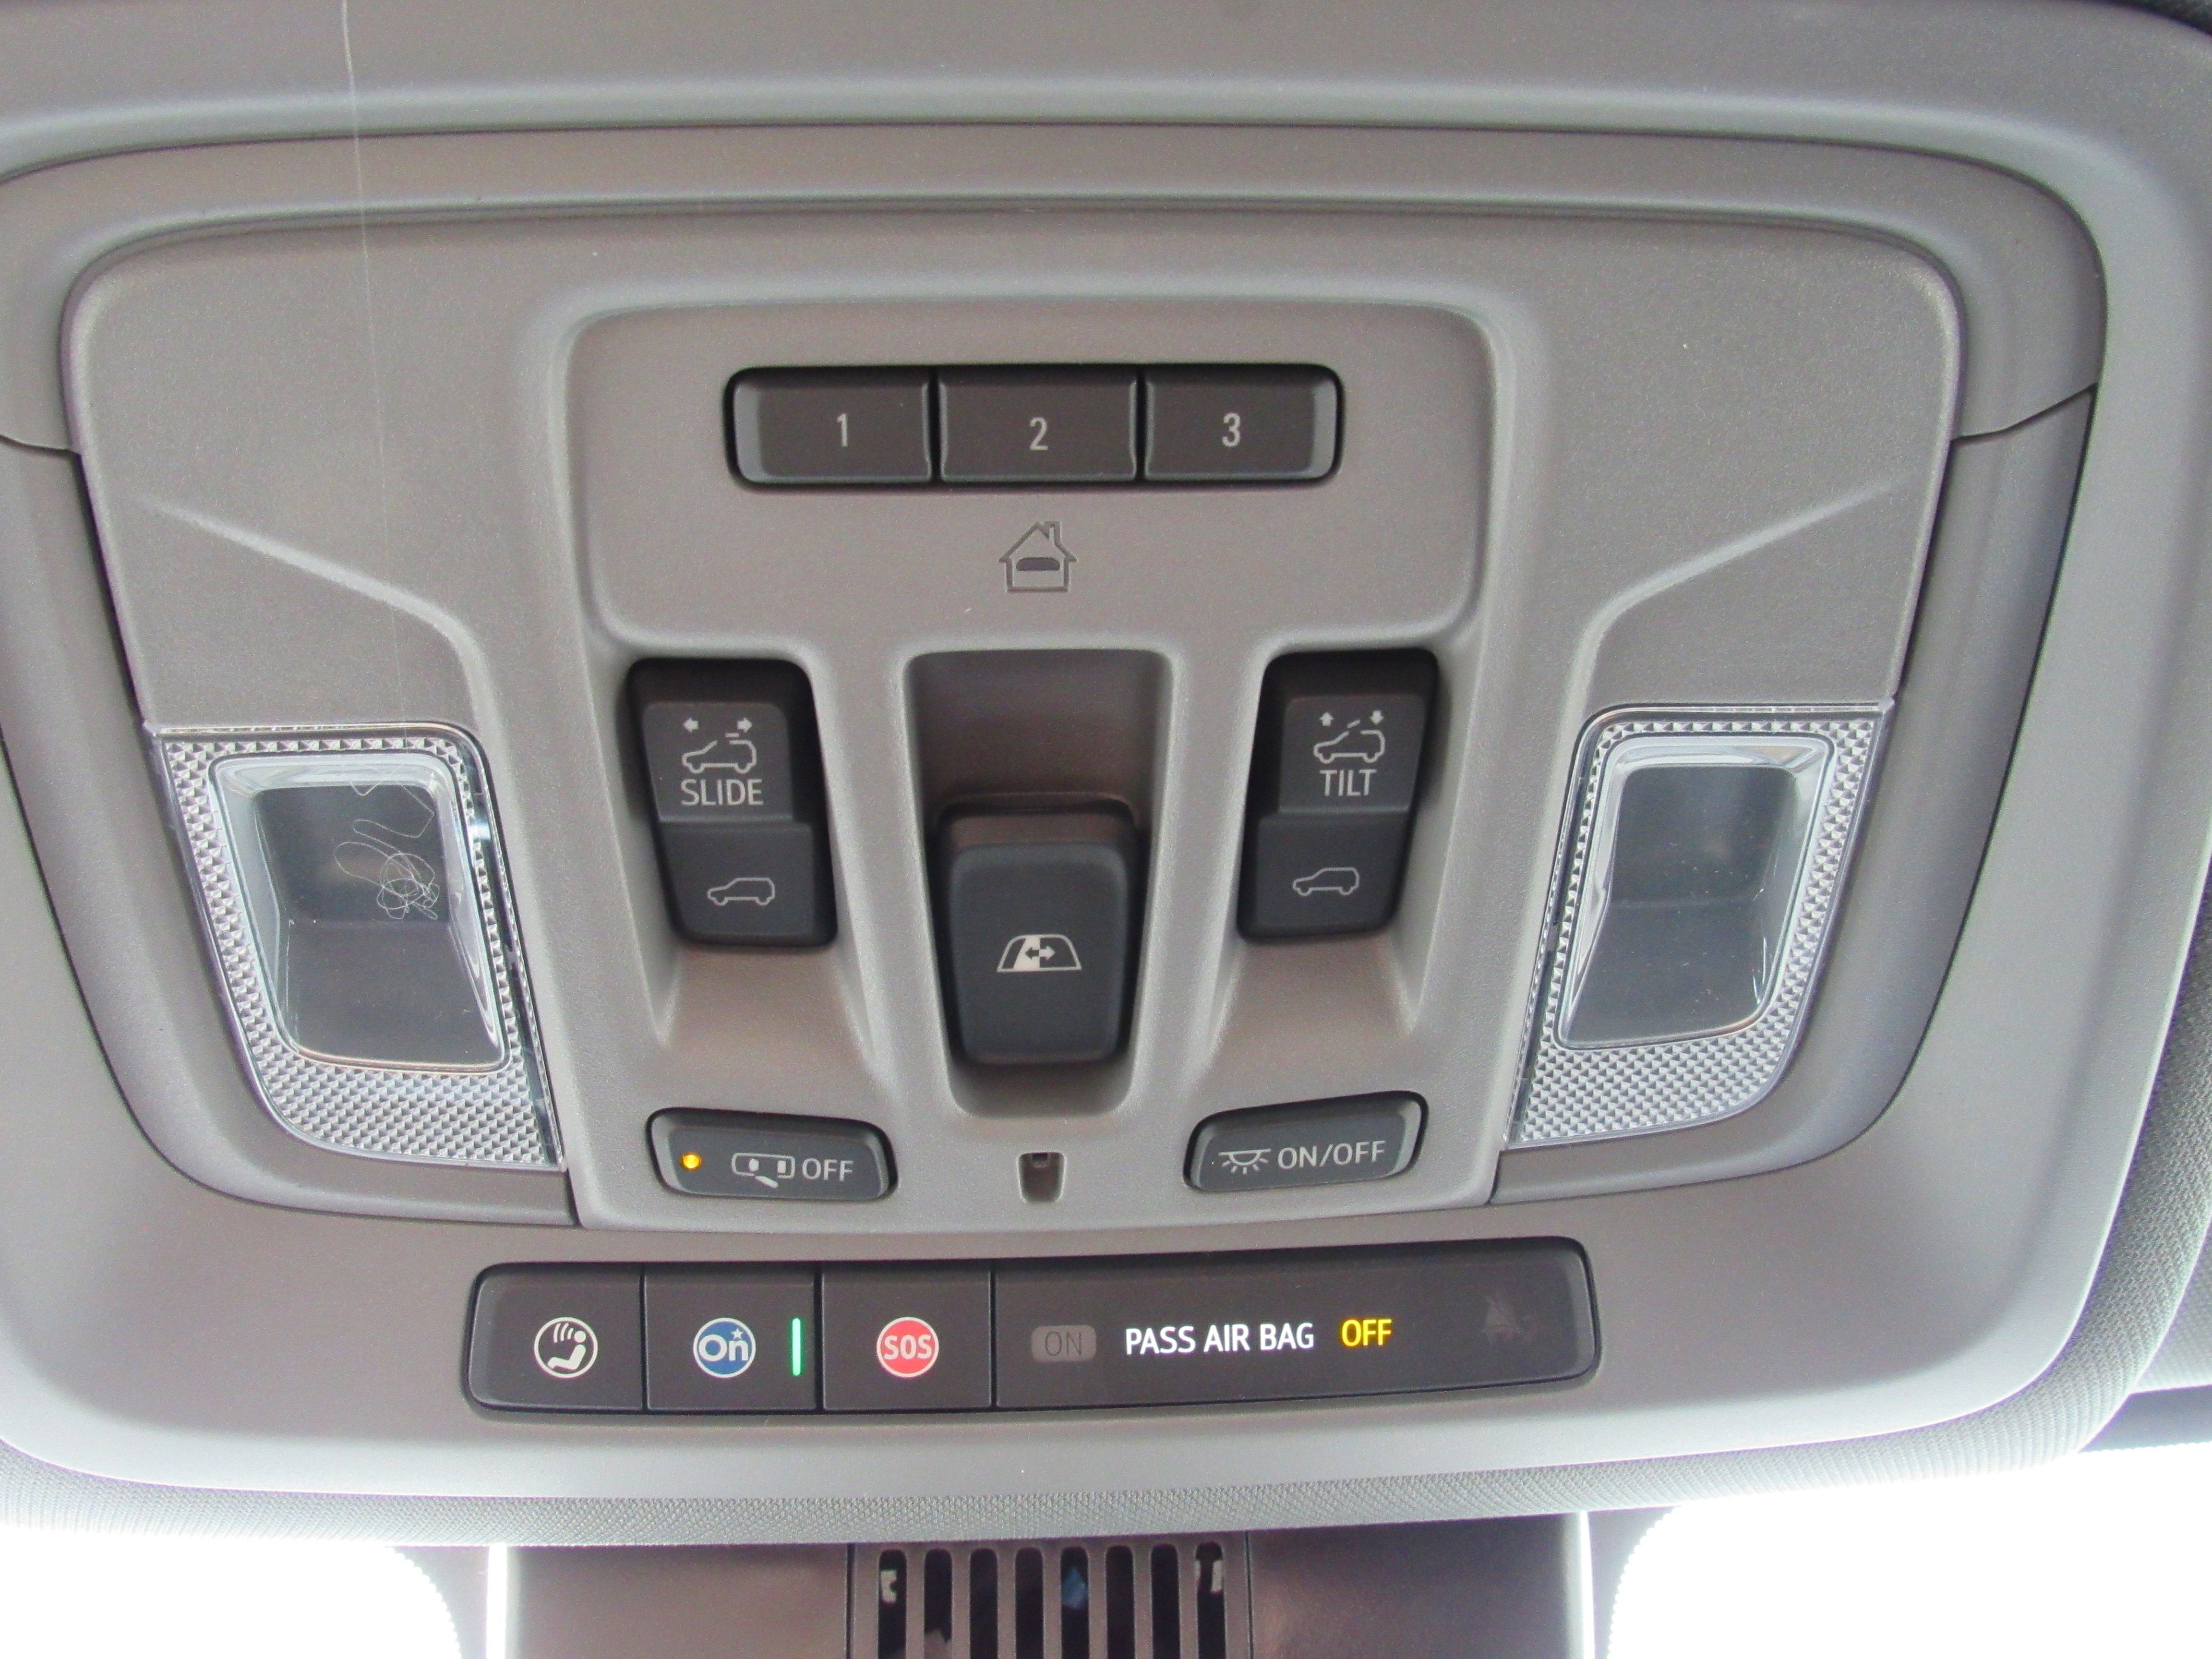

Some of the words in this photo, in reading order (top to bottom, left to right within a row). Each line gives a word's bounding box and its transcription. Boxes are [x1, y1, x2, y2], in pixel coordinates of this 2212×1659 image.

[836, 412, 849, 447] 1
[1029, 417, 1049, 451] 2
[1221, 413, 1241, 447] 3
[681, 779, 764, 806] SLIDE
[1320, 769, 1377, 796] TILT
[802, 1157, 854, 1181] OFF
[1278, 1140, 1386, 1170] ON/OFF
[1045, 1331, 1083, 1358] ON
[1125, 1326, 1195, 1355] PASS
[1203, 1324, 1251, 1353] AIR
[1260, 1322, 1315, 1351] BAG
[1341, 1318, 1392, 1346] OFF
[884, 1333, 933, 1361] SOS
